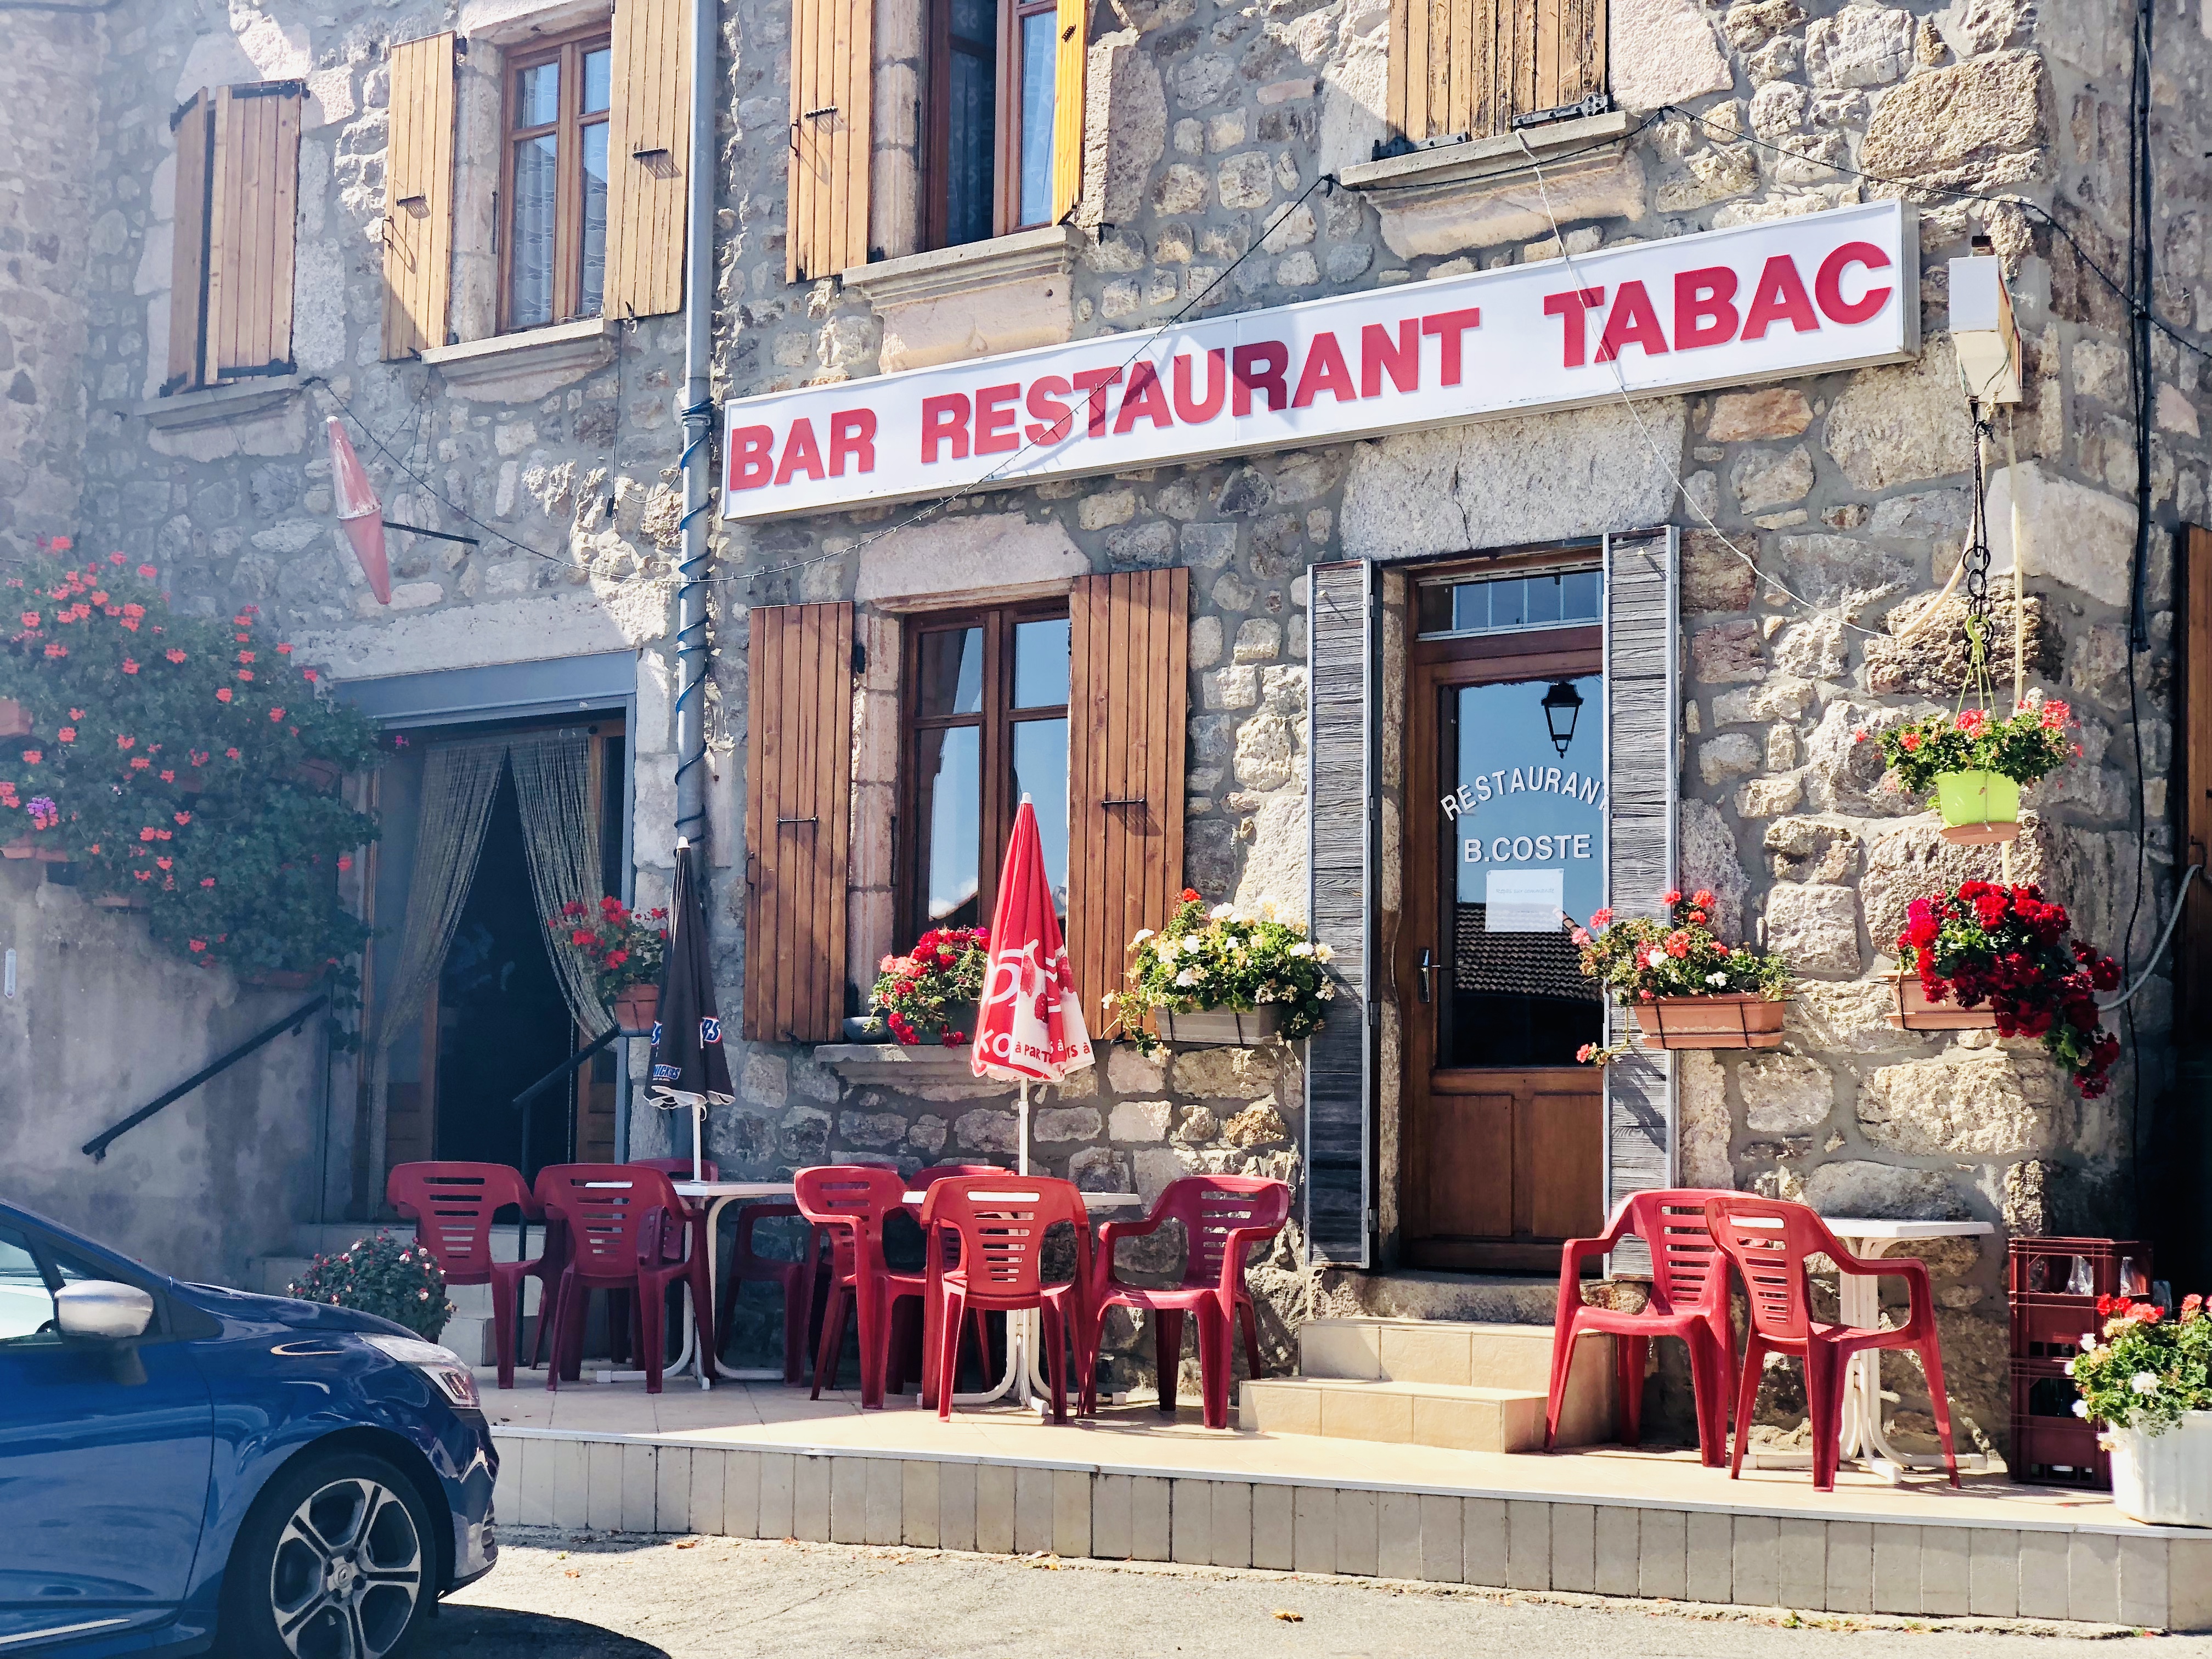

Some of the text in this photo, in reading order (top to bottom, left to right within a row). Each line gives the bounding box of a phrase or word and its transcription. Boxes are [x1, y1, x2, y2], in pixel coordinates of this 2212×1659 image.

[730, 241, 1892, 492] BAR RESTAURANT TABAC
[1441, 766, 1606, 821] RESTAURAN
[1464, 834, 1591, 863] B.COSTE
